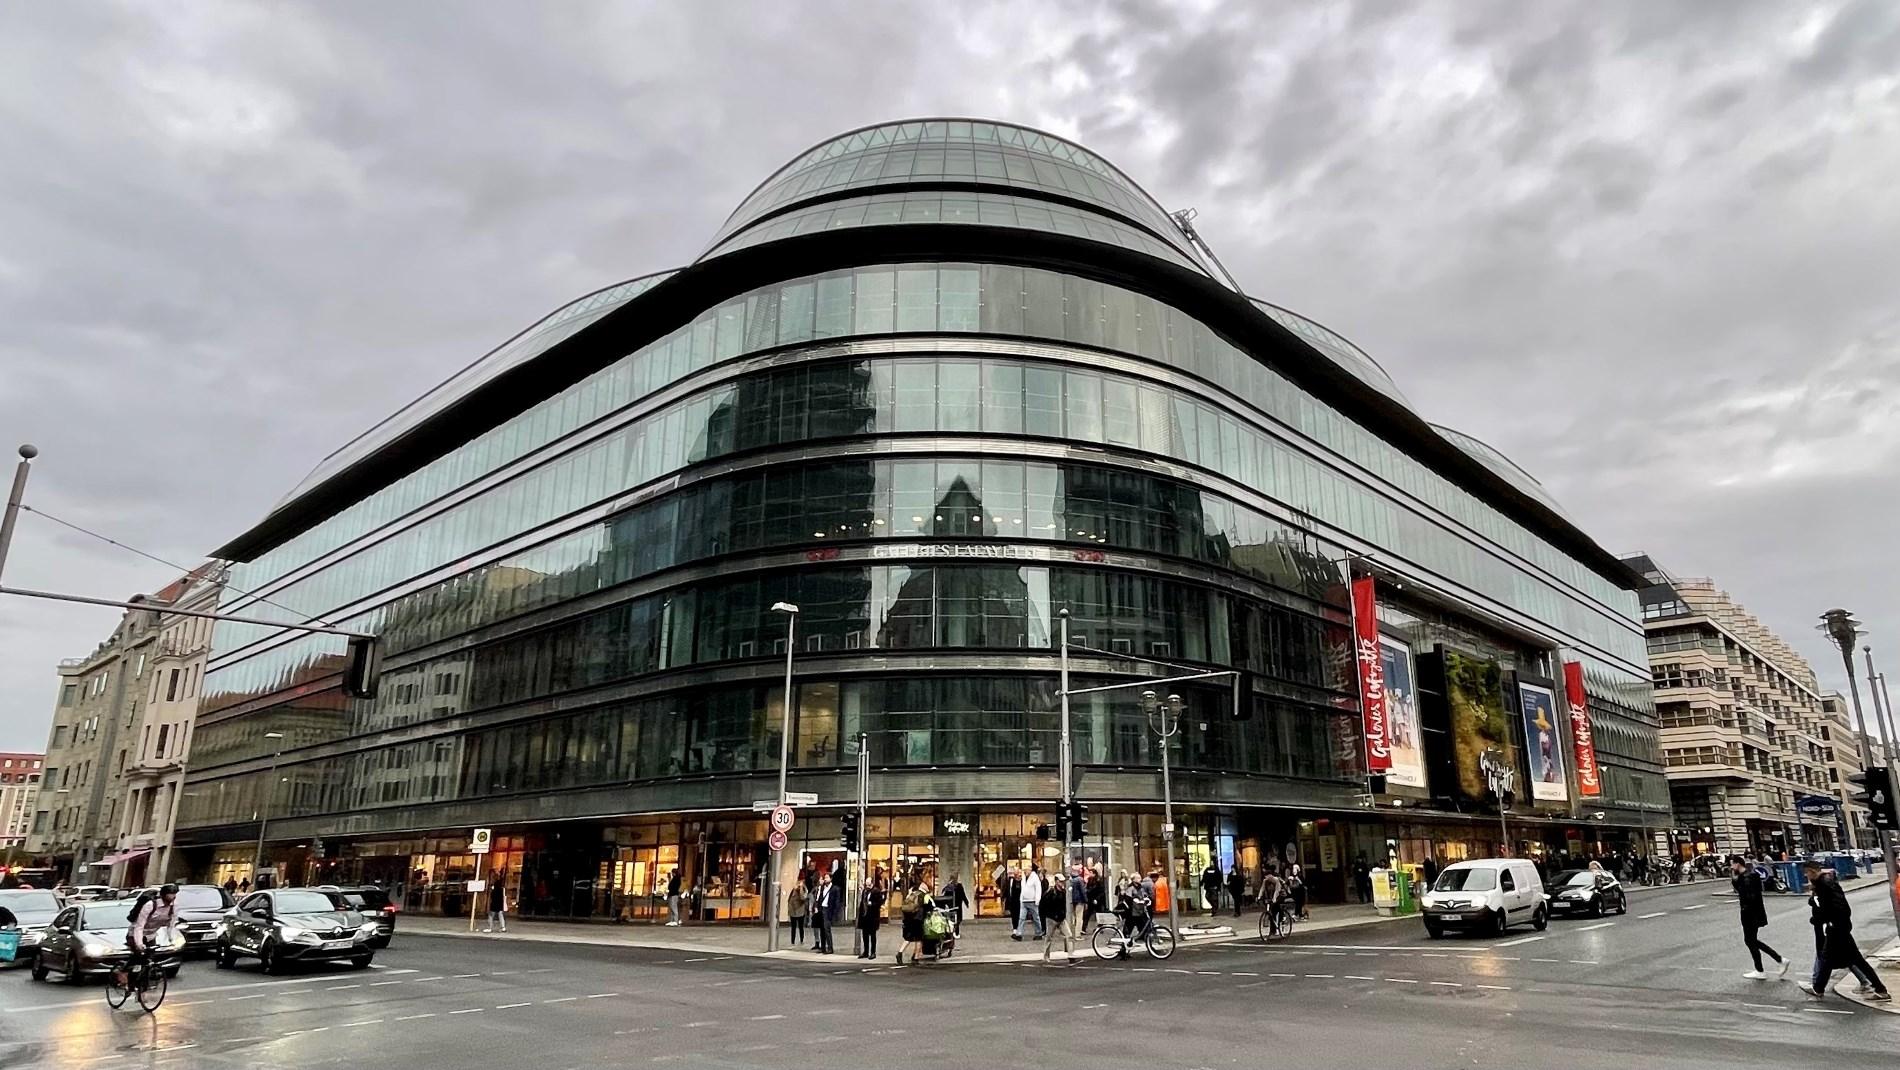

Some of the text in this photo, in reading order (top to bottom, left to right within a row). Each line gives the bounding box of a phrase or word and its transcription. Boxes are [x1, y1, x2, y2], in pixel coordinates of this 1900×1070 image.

[1365, 703, 1390, 758] Galeries
[1579, 749, 1598, 786] Galeries
[776, 812, 790, 824] 30
